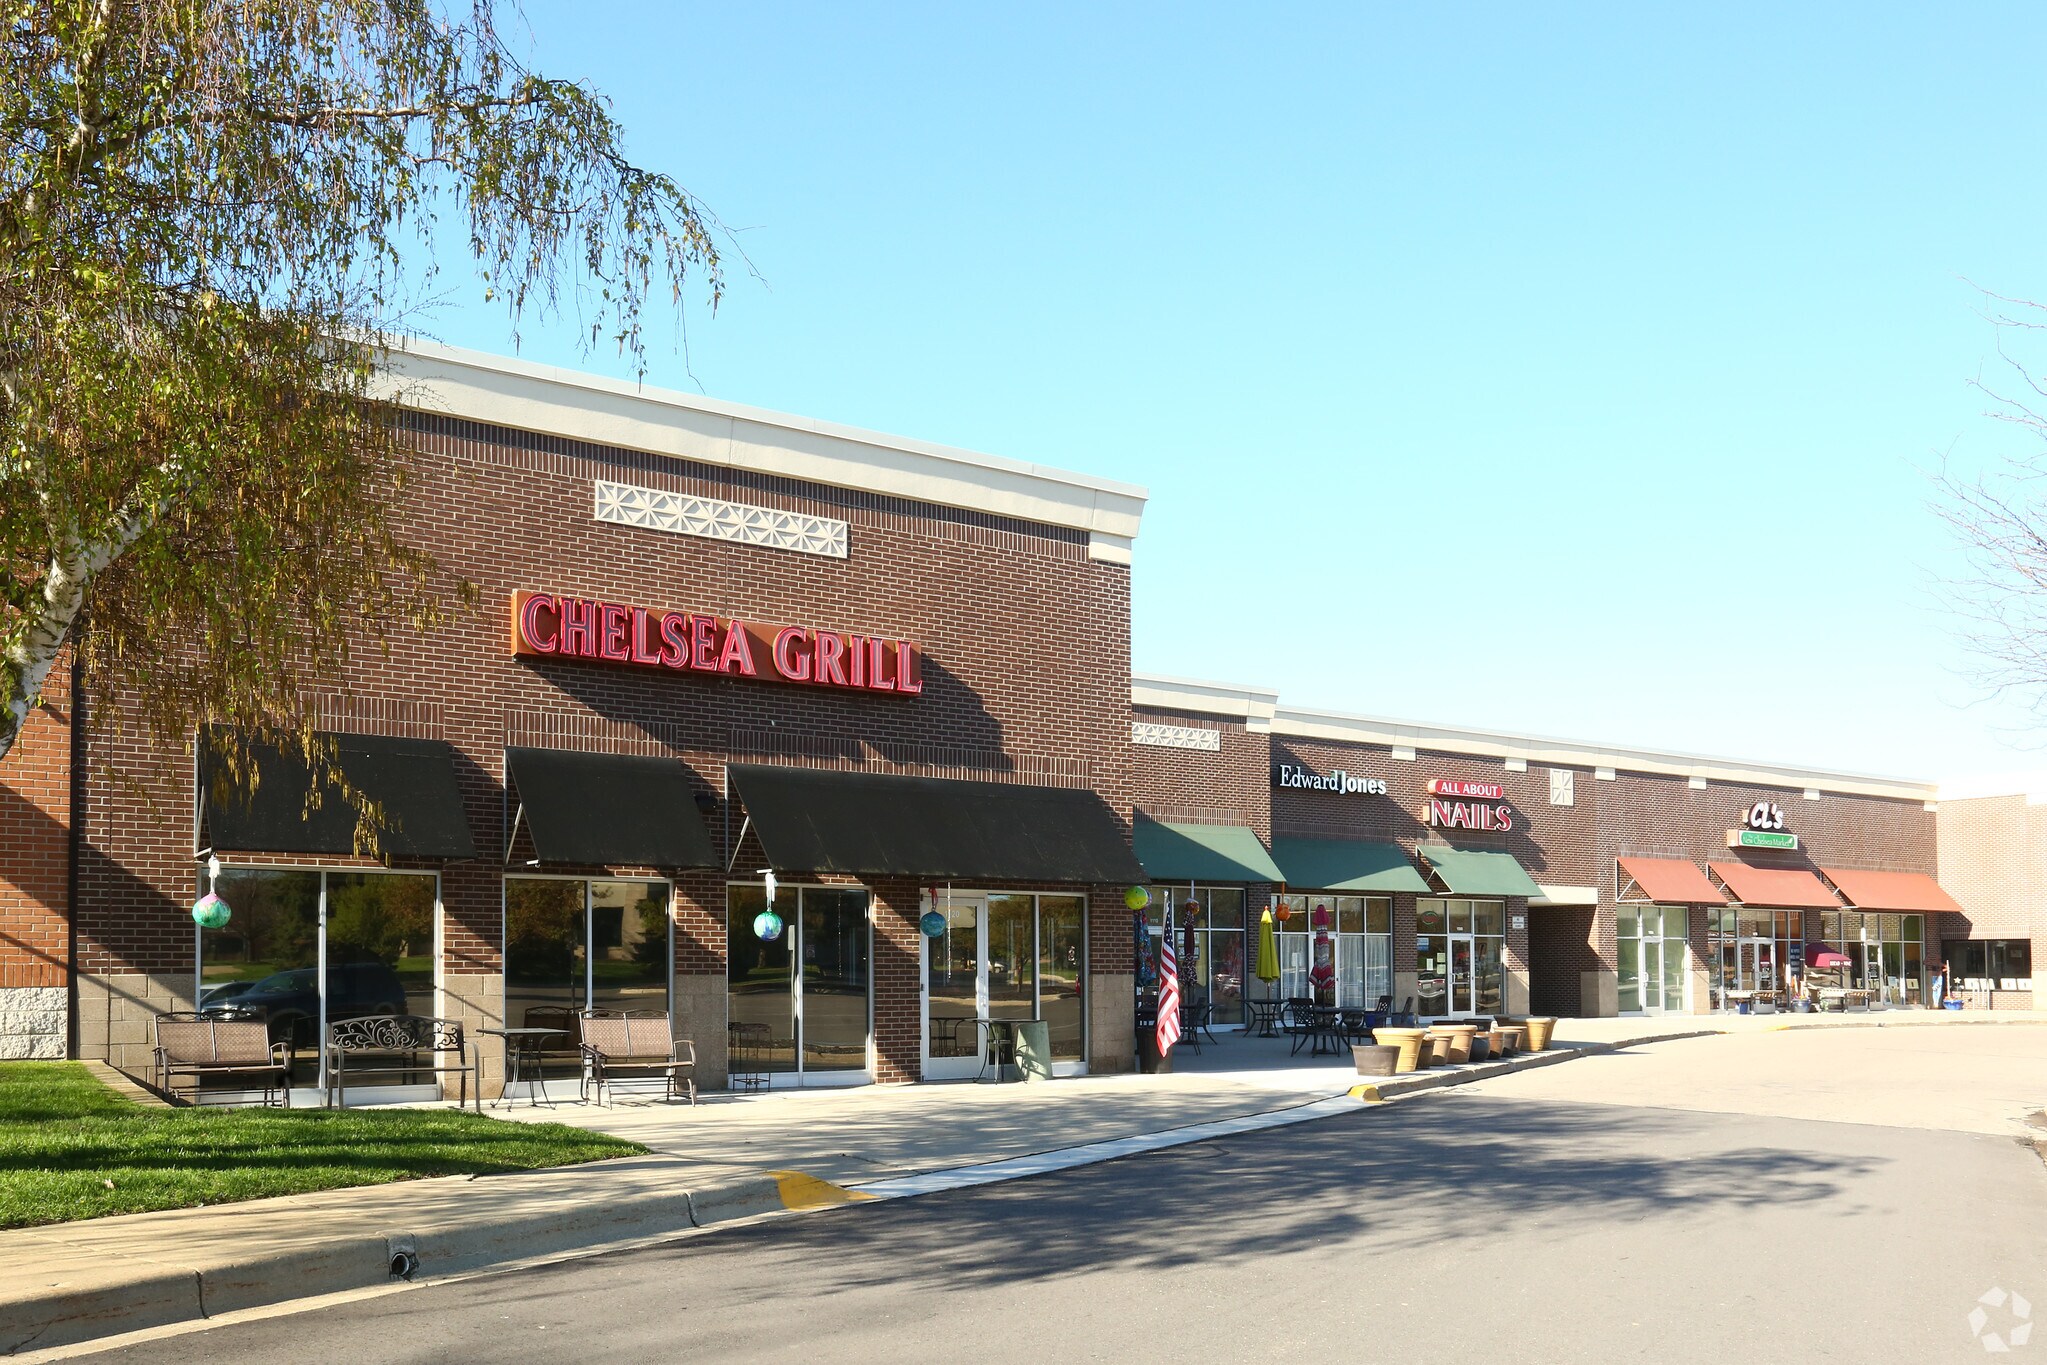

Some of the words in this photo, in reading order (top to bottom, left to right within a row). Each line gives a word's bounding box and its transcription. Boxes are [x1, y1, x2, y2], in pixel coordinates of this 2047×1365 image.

[520, 593, 757, 676] CHELSEA
[772, 626, 923, 694] GRILL
[1441, 782, 1460, 793] ALL
[1463, 784, 1498, 797] ABOUT
[1431, 800, 1512, 831] NAILS
